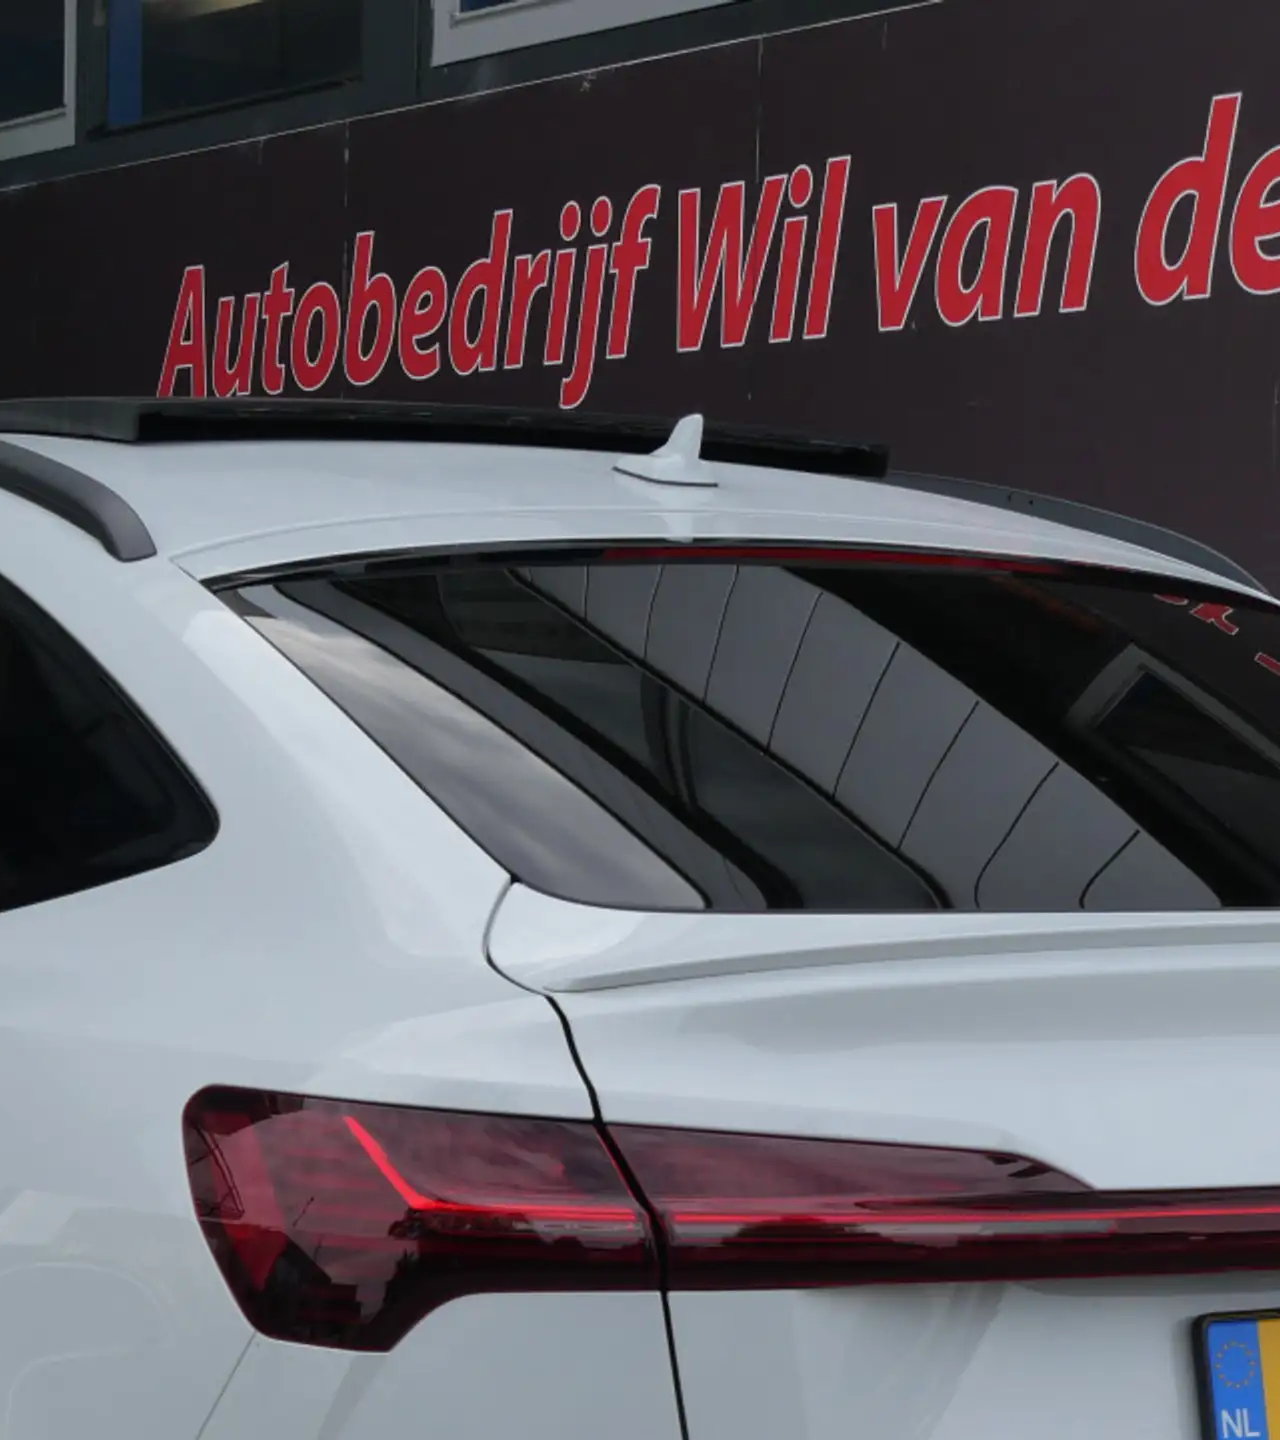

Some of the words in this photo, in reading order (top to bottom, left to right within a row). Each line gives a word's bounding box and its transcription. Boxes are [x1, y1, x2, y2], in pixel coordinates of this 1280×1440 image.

[157, 184, 660, 410] Autobedrijf
[677, 154, 851, 352] Wil
[872, 172, 1102, 332] van
[1220, 1408, 1261, 1440] NL
